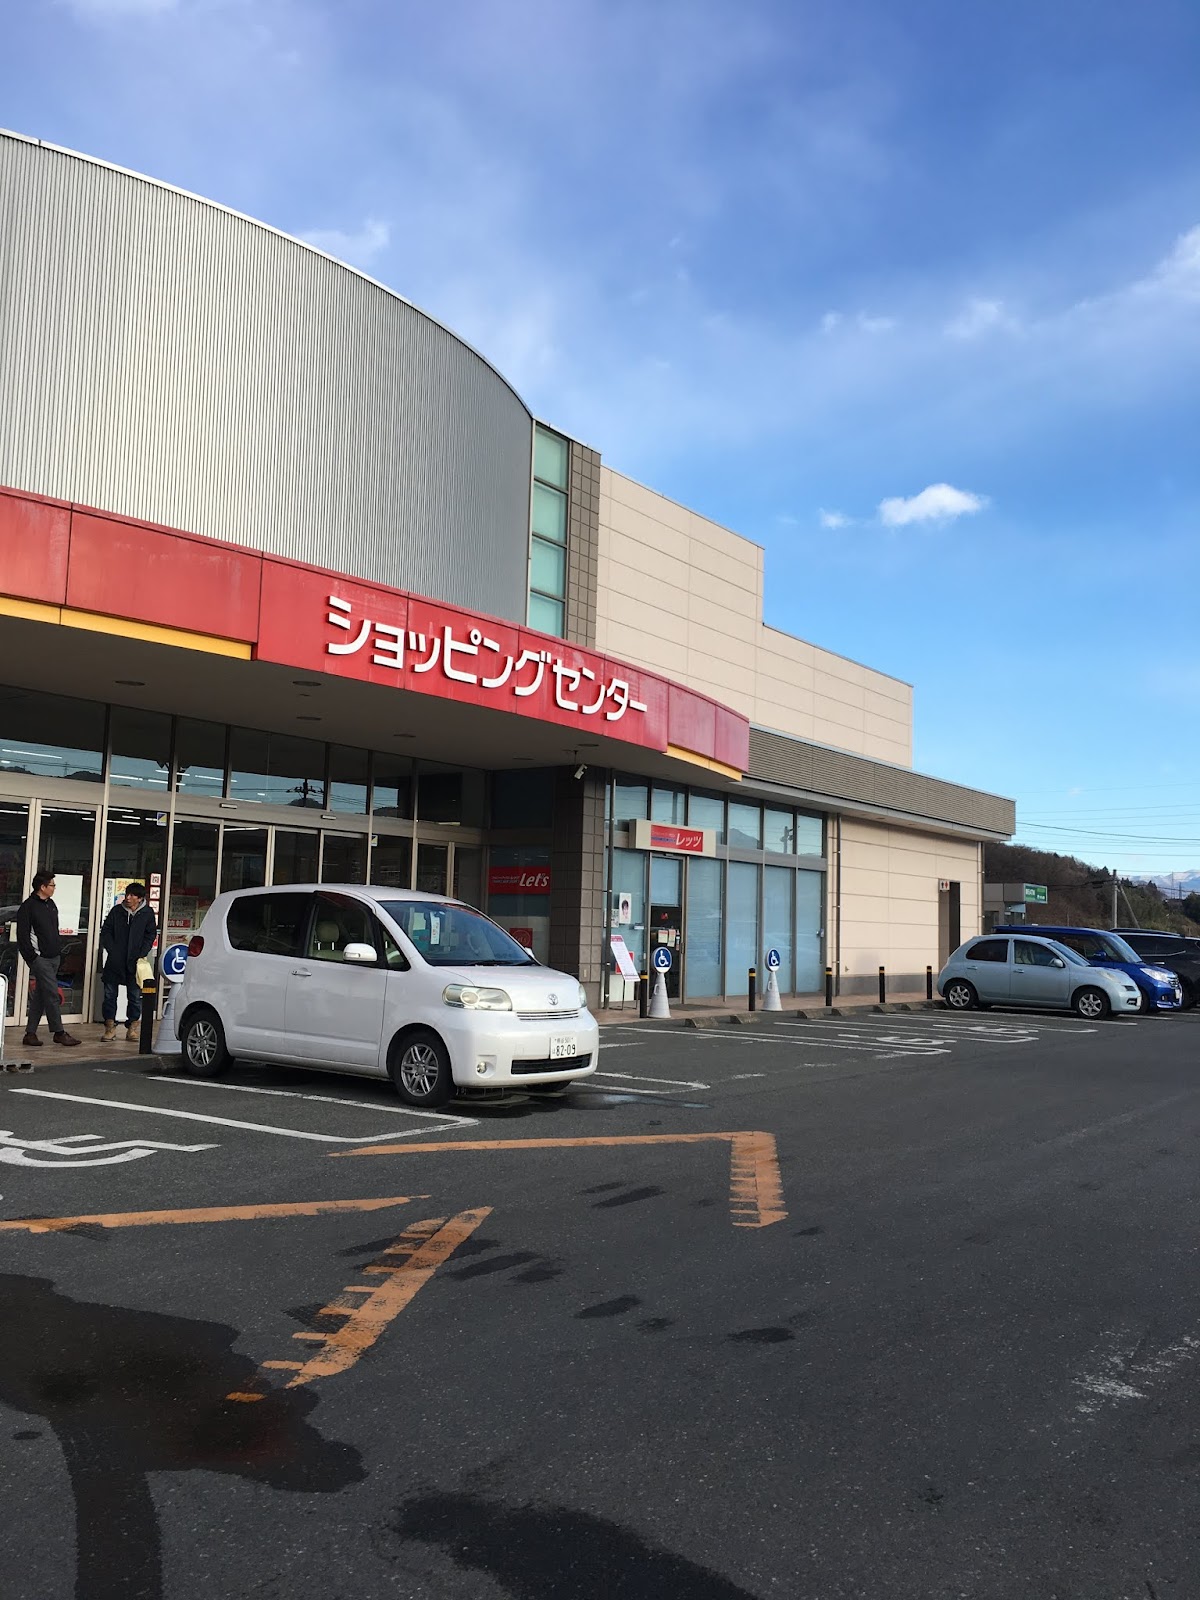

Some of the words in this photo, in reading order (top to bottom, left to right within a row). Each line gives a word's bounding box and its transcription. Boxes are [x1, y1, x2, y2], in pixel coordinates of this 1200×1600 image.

[326, 595, 648, 722] ショッピングセンター
[675, 832, 702, 848] レッツ
[519, 872, 550, 887] Let's
[556, 1044, 575, 1056] 82-09
